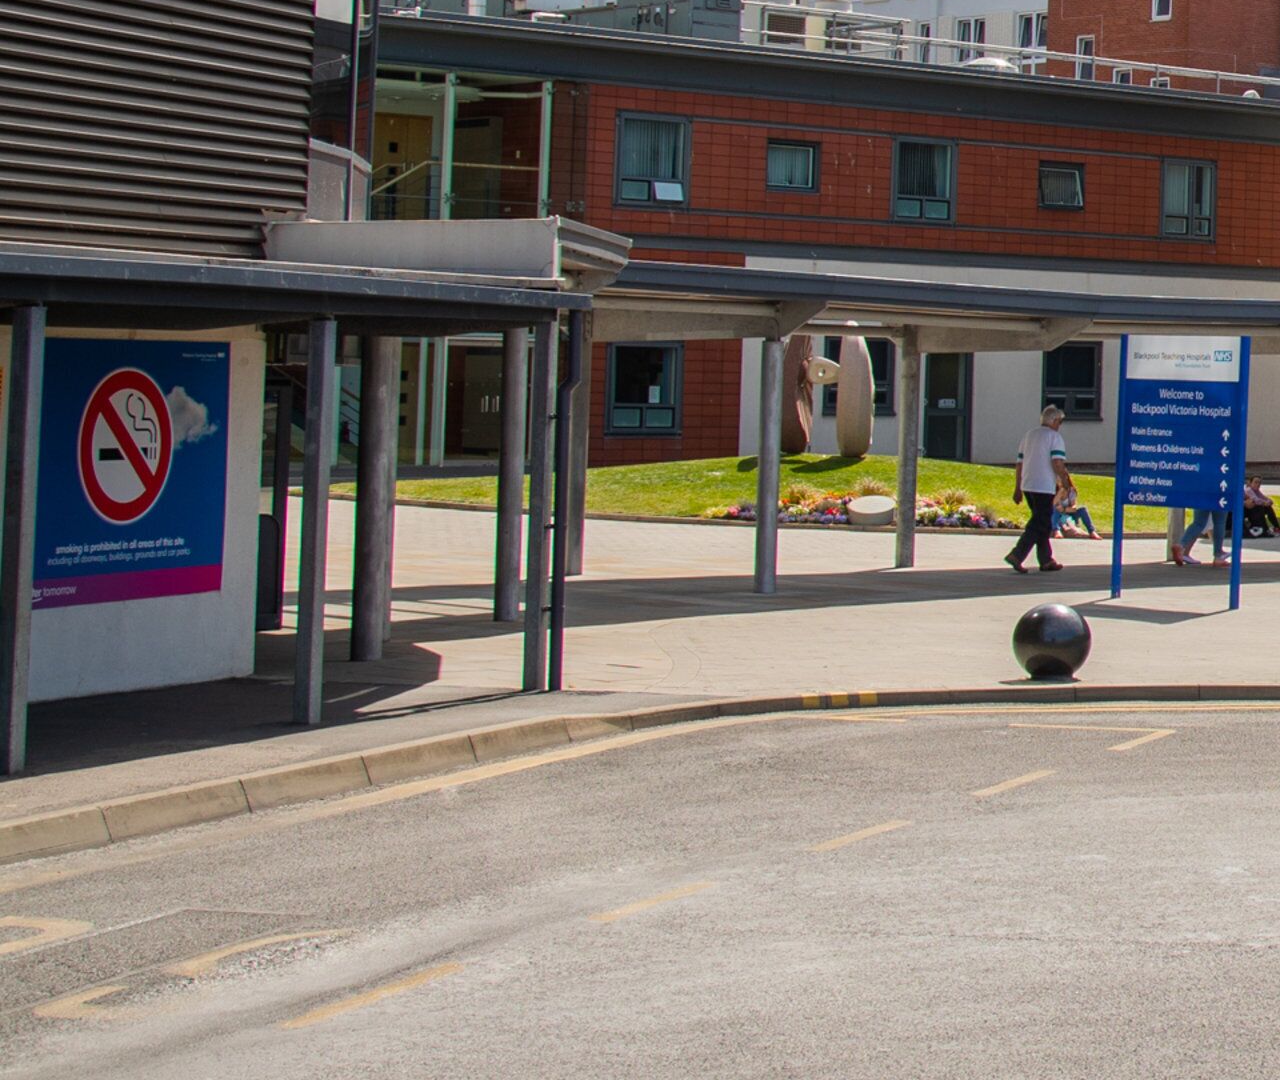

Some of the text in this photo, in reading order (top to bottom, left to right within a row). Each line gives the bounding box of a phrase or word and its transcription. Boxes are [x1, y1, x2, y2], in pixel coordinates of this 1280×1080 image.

[1134, 351, 1211, 361] Blackpool Teaching Hospitals
[1214, 351, 1232, 361] NHS
[1159, 388, 1204, 400] Welcome to
[1132, 403, 1232, 418] Blackpool Victoria Hospital
[1131, 427, 1172, 436] Main Entrance
[1131, 443, 1204, 454] Womens & Childrens Unit
[1130, 459, 1200, 472] Maternity (Out of Hours)
[1129, 476, 1172, 486] All Other Areas
[1128, 492, 1167, 502] Cycle Shelter
[56, 537, 184, 555] smoking is prohibited in all areas of this site
[47, 556, 72, 566] including
[134, 550, 155, 561] grounds
[157, 549, 167, 557] and
[176, 547, 191, 557] parks
[43, 585, 77, 597] tomorrow
